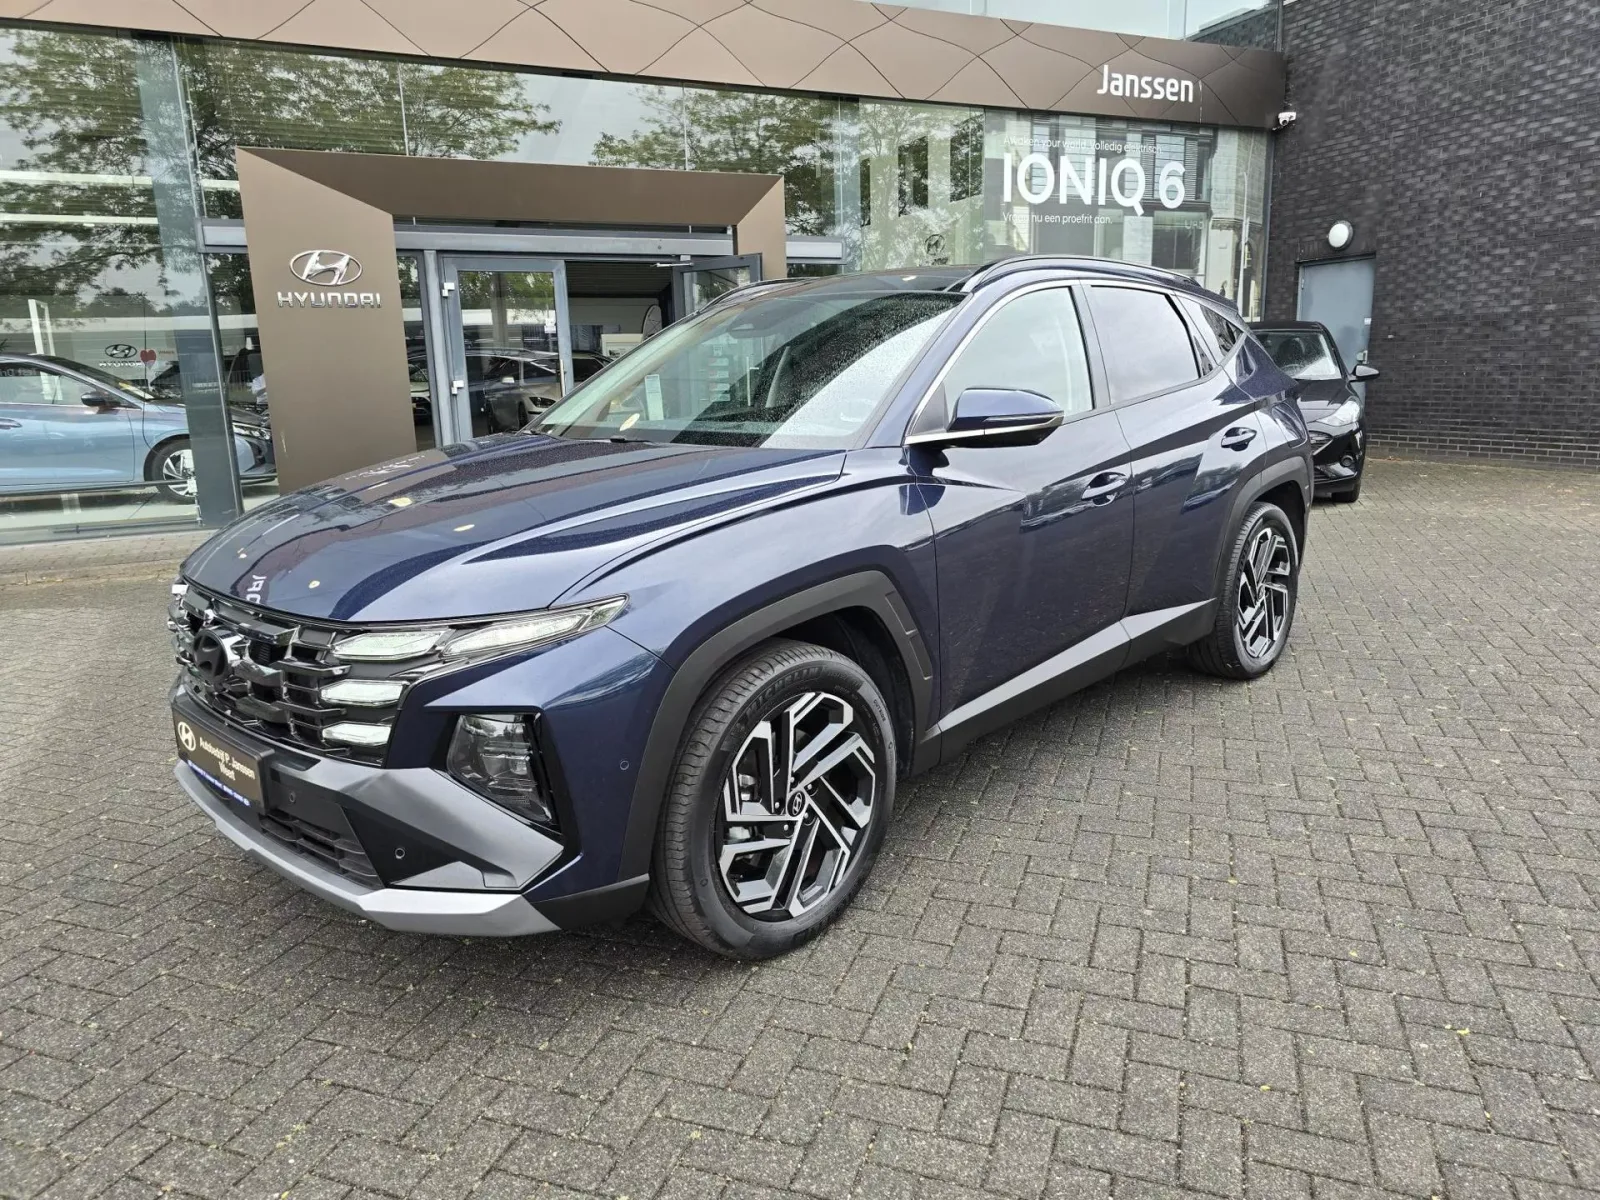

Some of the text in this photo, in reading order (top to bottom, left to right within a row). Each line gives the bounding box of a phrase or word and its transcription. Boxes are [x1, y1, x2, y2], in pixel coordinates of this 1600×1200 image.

[1097, 64, 1194, 103] Janssen
[1040, 139, 1061, 151] your
[1090, 139, 1123, 154] Volledig
[1003, 152, 1186, 217] IONIQ 6
[1002, 212, 1113, 226] Vraag nu een proefrit aan.
[277, 291, 382, 308] HYUNDAI
[745, 666, 821, 718] MICHELIN
[232, 757, 256, 780] Janssen
